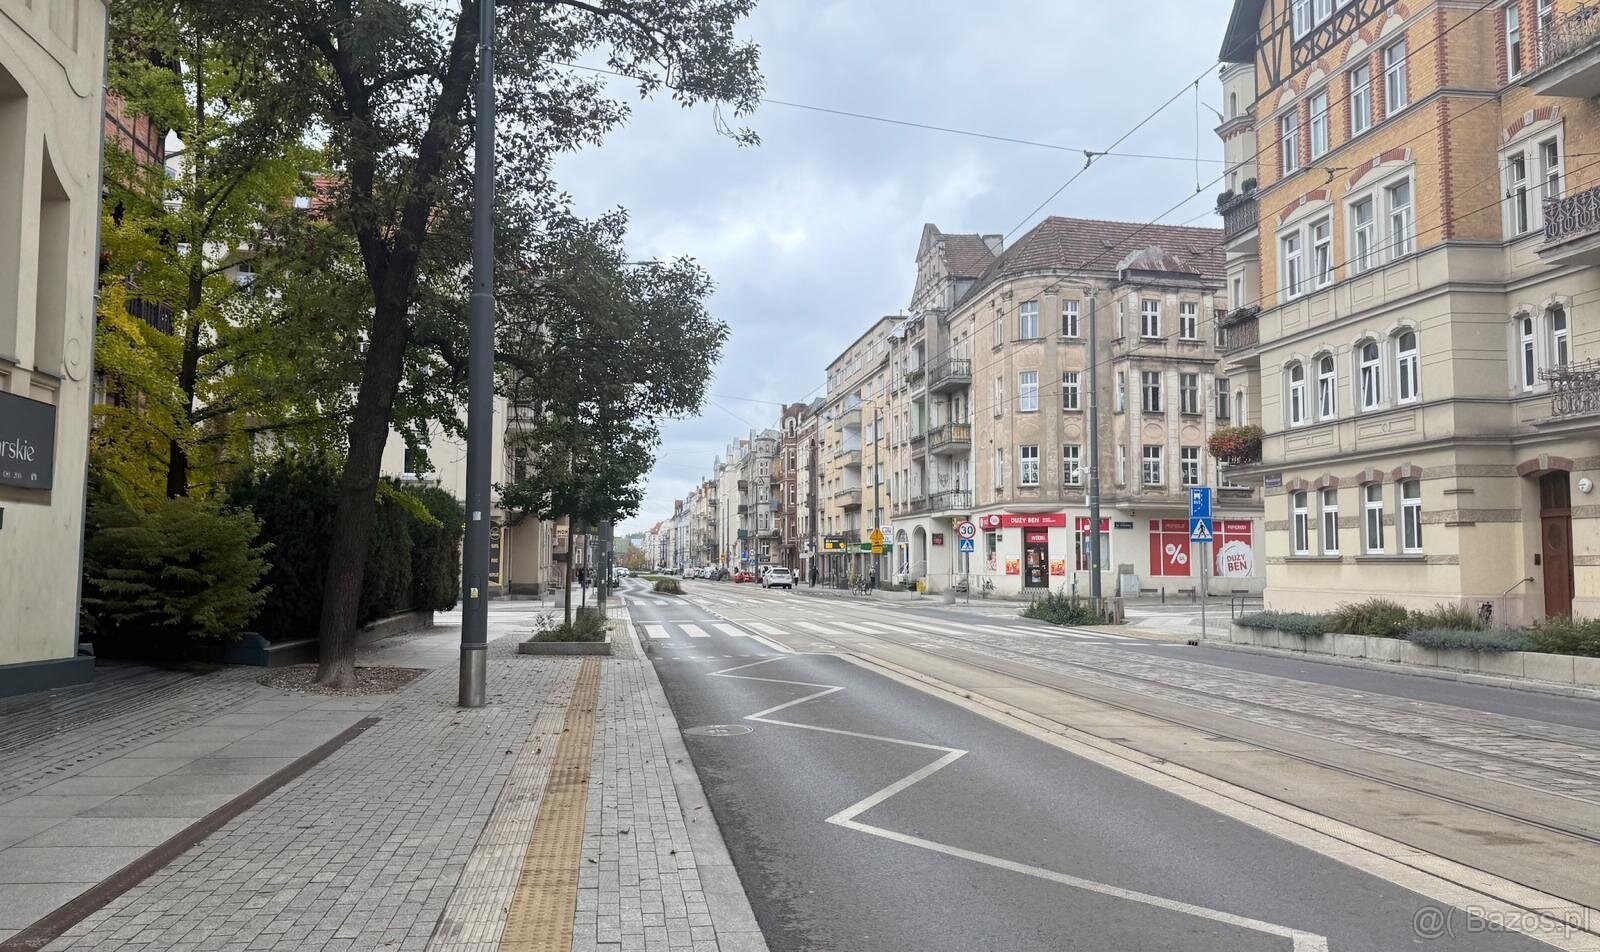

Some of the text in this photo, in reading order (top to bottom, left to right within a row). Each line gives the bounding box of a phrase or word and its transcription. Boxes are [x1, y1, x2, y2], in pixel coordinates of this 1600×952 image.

[961, 526, 973, 534] 30
[1227, 553, 1245, 562] DUŻY
[1228, 561, 1248, 572] BEN
